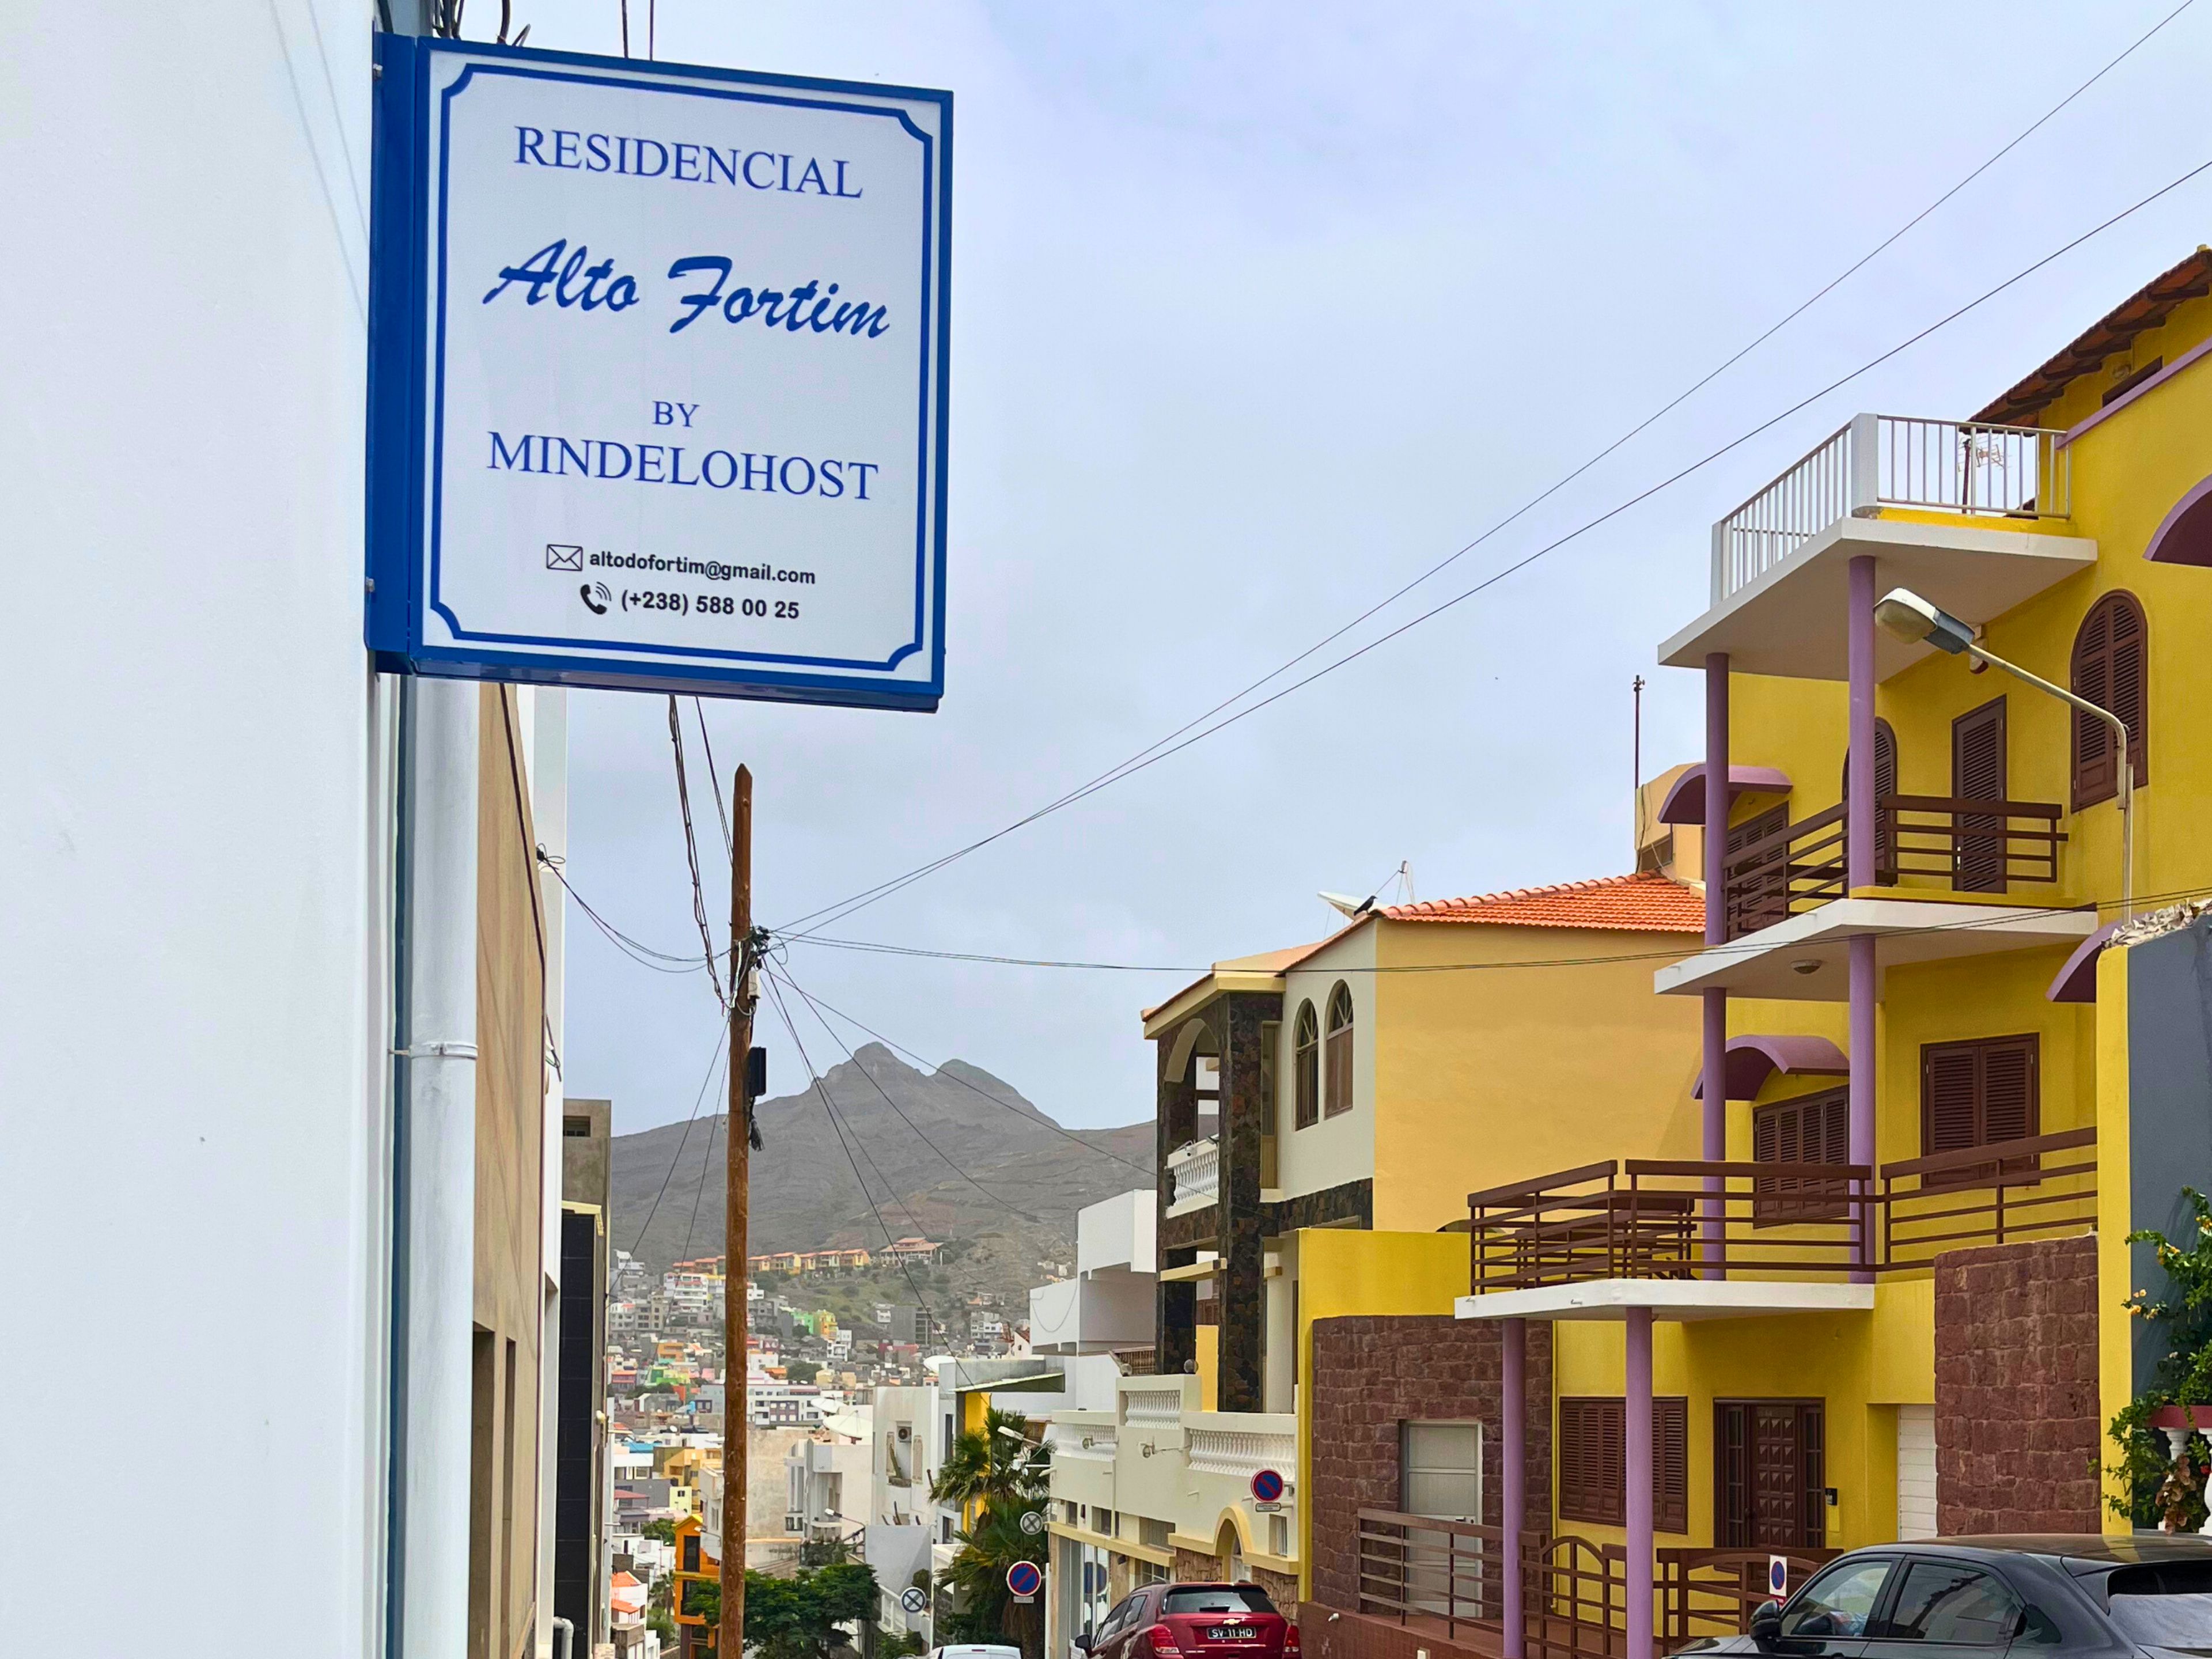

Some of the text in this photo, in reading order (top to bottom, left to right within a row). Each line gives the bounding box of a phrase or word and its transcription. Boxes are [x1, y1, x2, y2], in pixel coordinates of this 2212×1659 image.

[514, 126, 862, 199] RESIDENCIAL
[482, 238, 890, 339] Alto Fortim
[653, 400, 699, 428] BY
[487, 431, 878, 500] MINDELOHOST
[590, 550, 816, 585] altodofortim@gmail.com
[621, 589, 800, 619] (+238) 588 00 25
